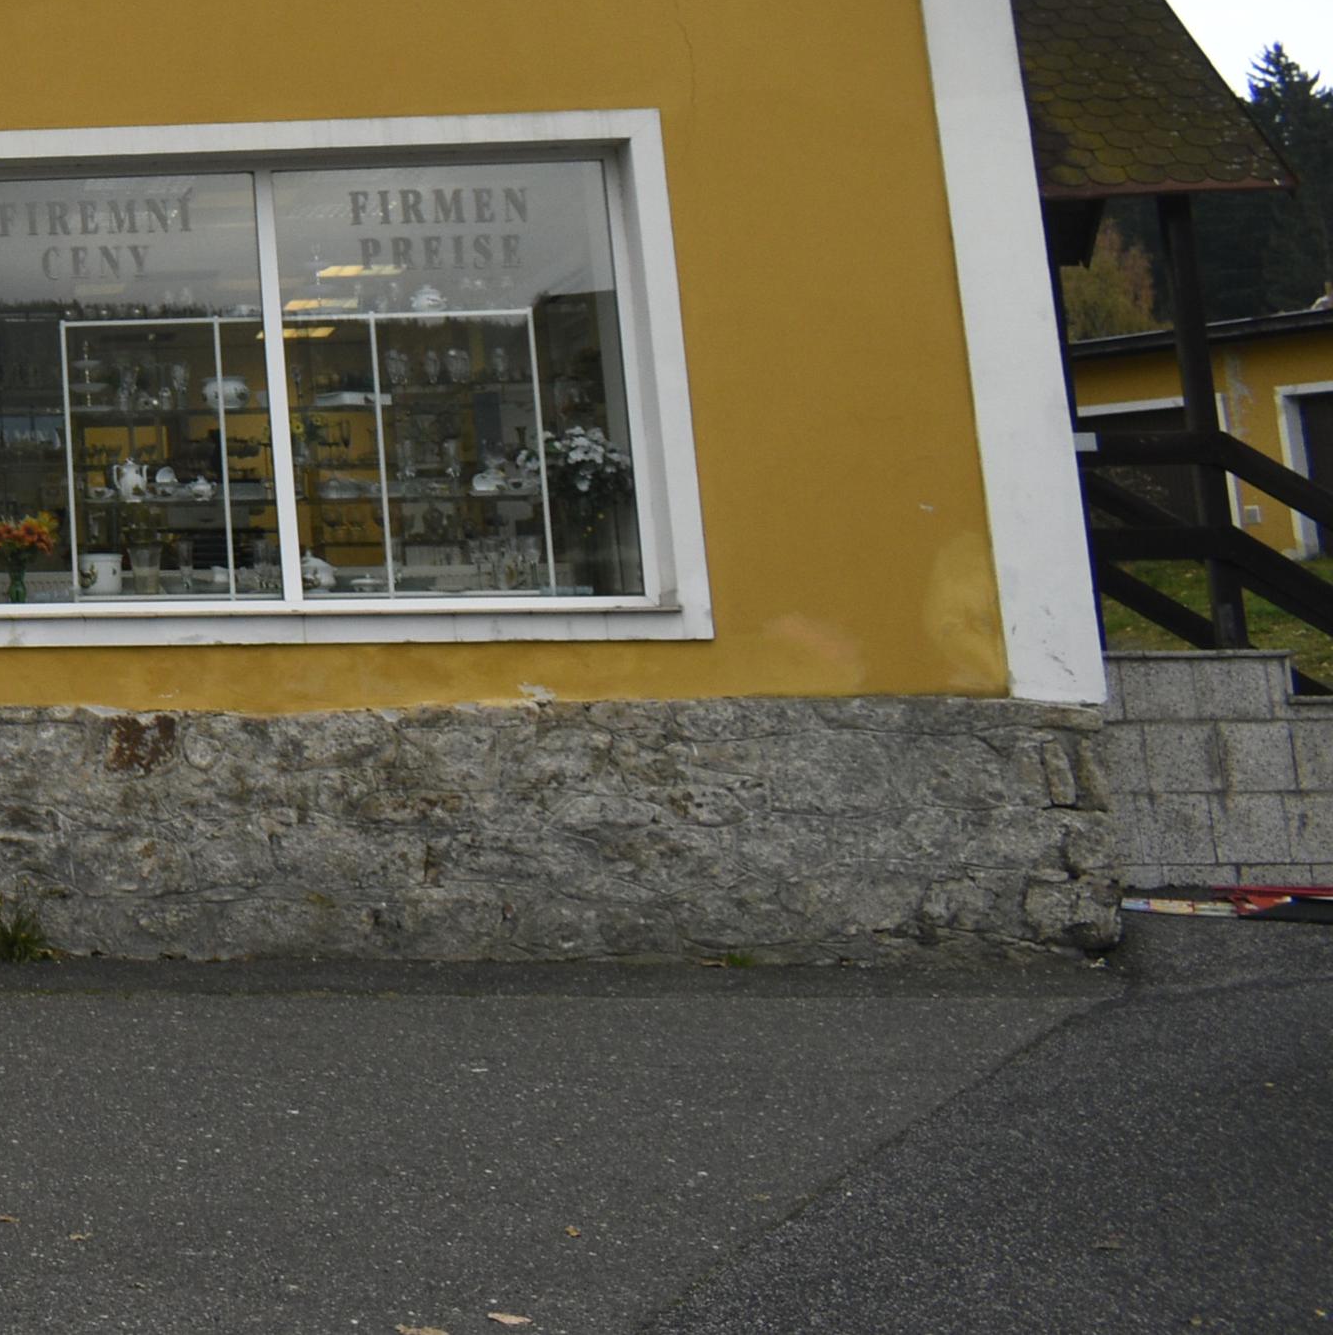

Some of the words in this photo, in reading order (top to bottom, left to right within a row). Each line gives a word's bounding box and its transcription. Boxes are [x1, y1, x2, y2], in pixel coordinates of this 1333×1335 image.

[348, 186, 529, 226] FIRMEN
[41, 244, 149, 280] CENY
[359, 233, 522, 271] PREISE
